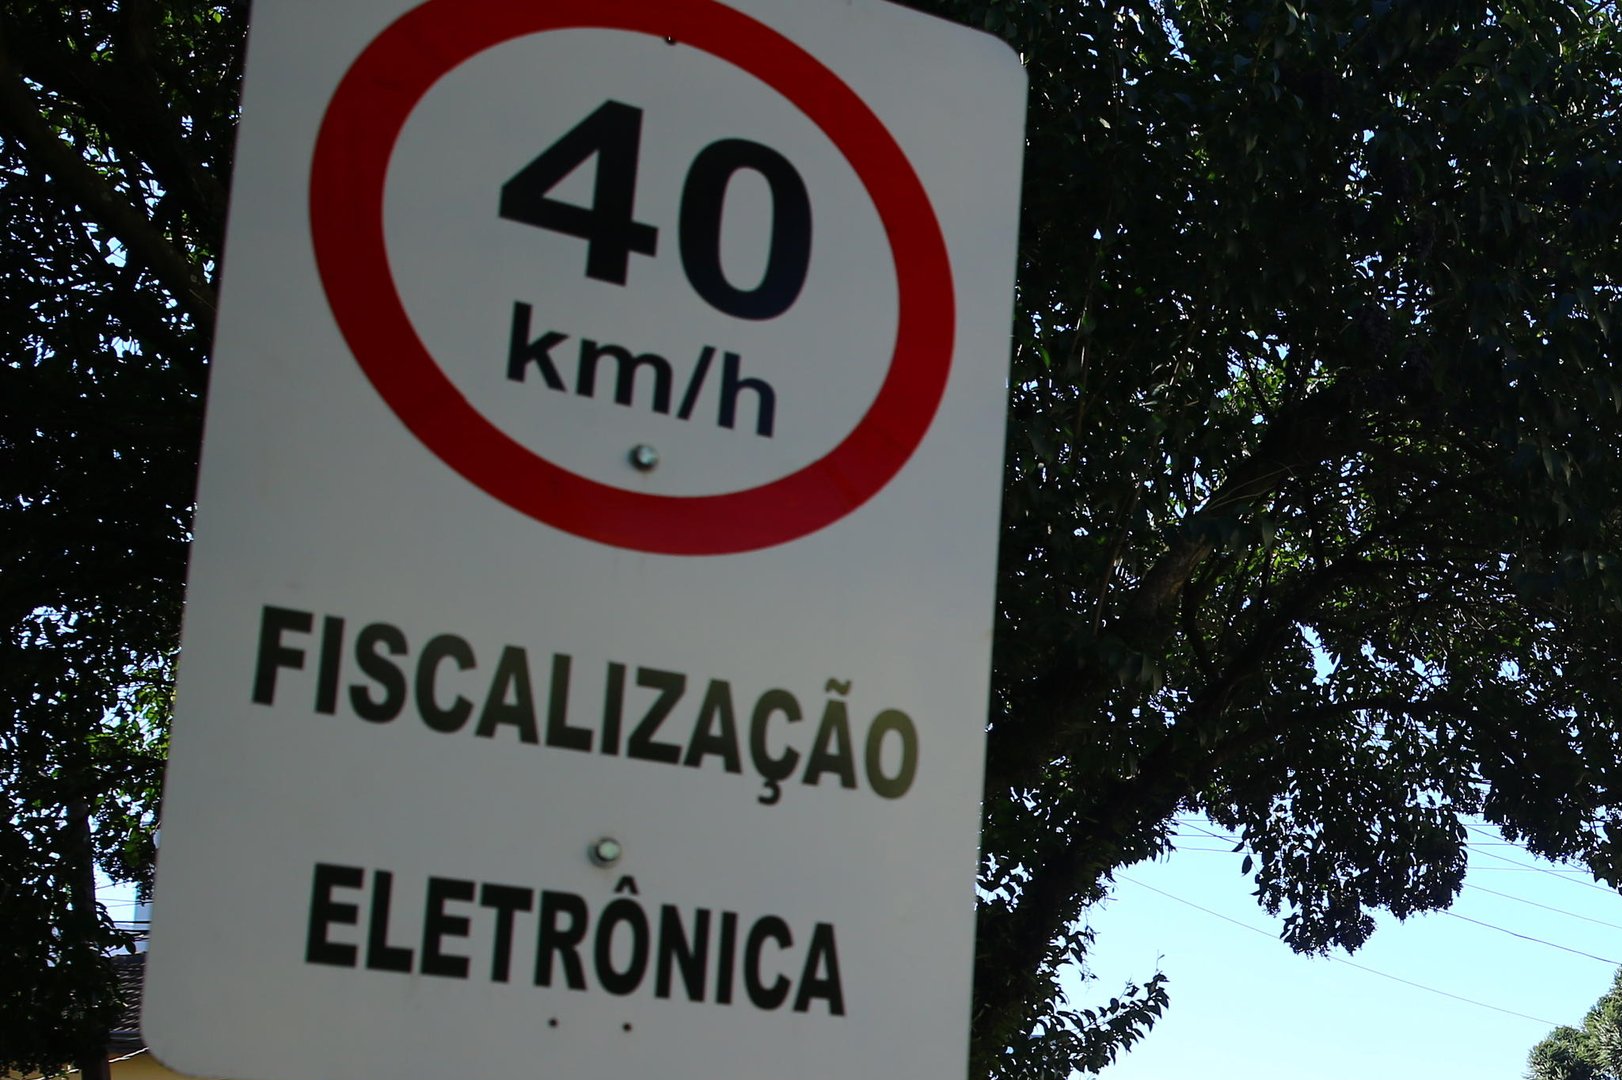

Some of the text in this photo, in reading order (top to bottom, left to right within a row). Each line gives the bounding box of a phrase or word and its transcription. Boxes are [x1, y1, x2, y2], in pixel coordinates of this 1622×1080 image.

[497, 99, 813, 321] 40
[505, 302, 777, 438] km/h
[250, 604, 920, 806] FISCALIZAÇÃO
[304, 862, 847, 1018] ELETRÔNICA
